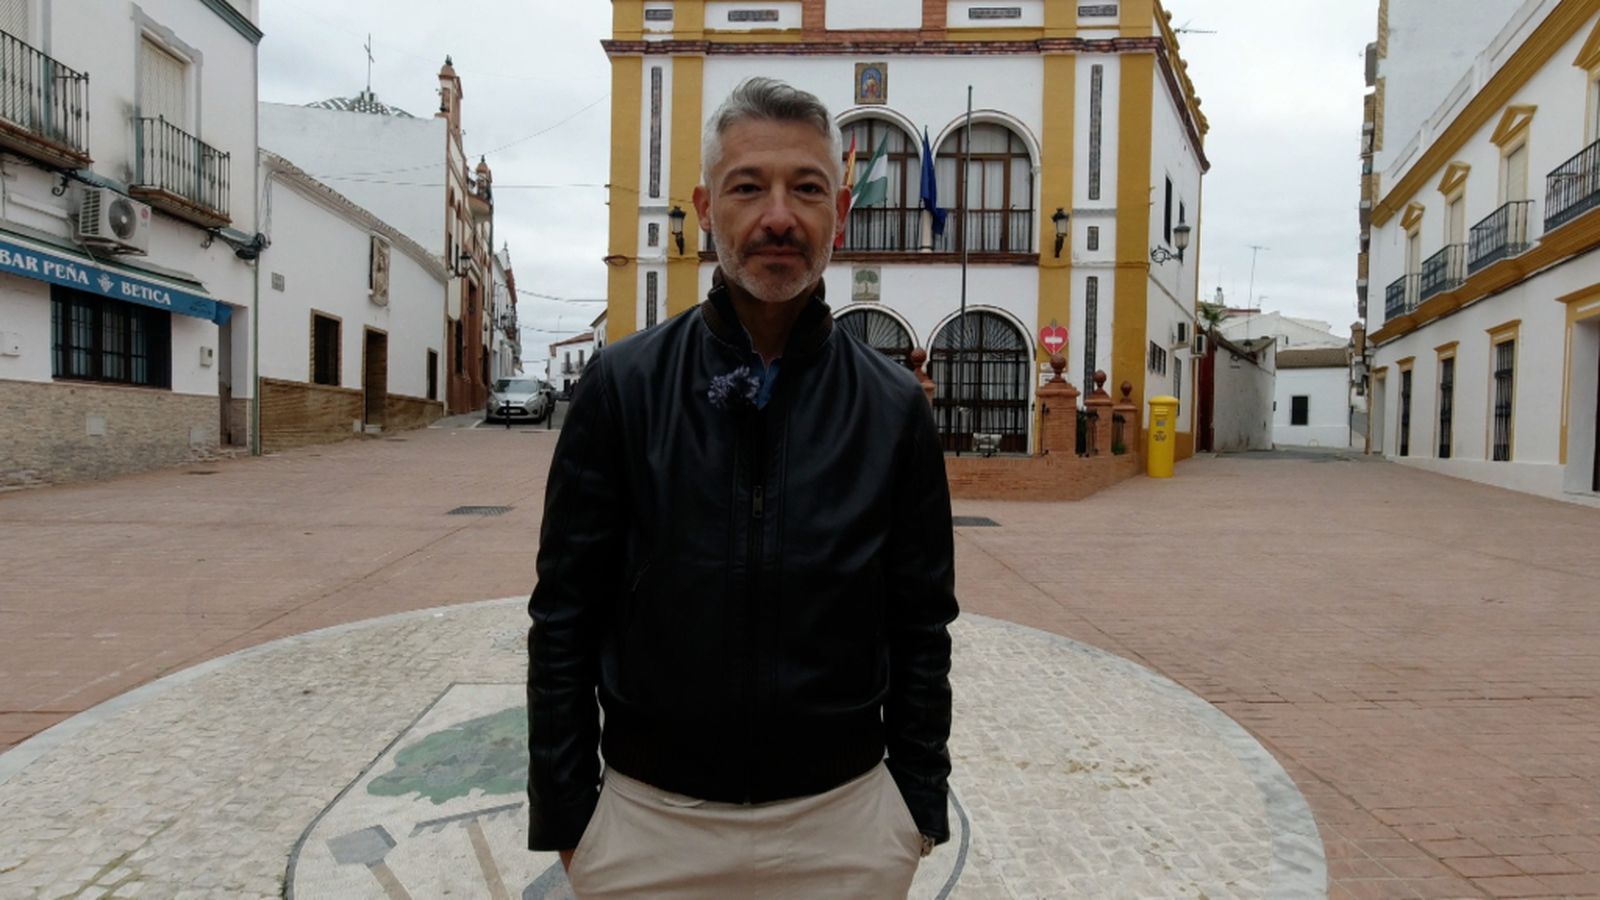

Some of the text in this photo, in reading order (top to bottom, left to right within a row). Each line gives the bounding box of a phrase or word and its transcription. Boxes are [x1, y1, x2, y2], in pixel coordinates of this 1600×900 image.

[0, 249, 172, 306] BAR PEÑA BETICA
